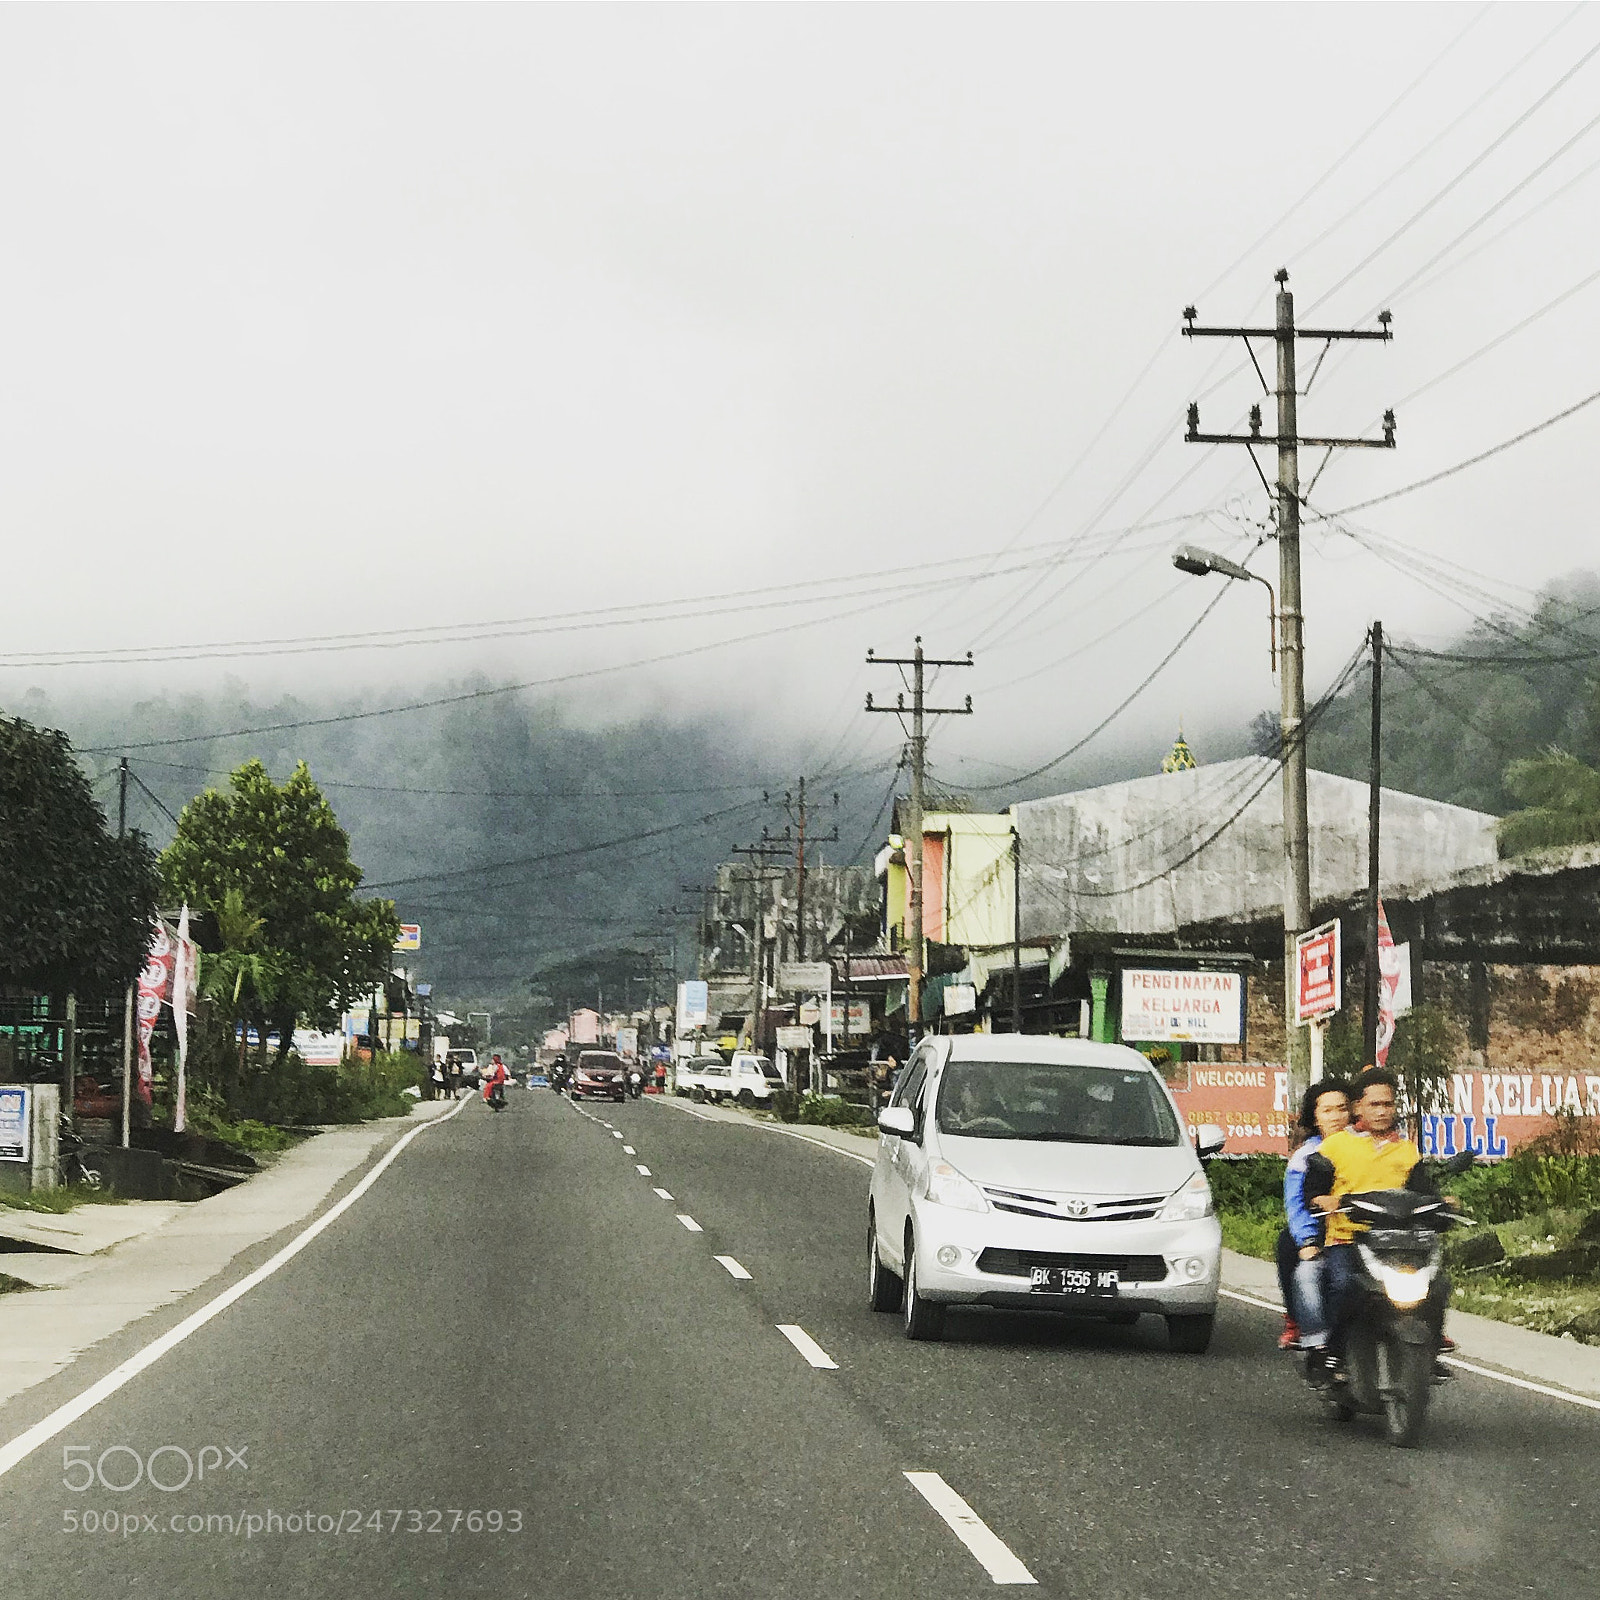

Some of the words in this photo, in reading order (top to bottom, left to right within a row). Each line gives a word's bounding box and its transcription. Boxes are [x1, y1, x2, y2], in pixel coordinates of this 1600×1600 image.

[1132, 974, 1232, 991] PENGINAPAN
[1141, 998, 1221, 1013] KELUARGA
[1195, 1071, 1267, 1087] WELCOME
[1226, 1124, 1263, 1138] 7094
[1420, 1114, 1508, 1159] HILL
[1032, 1269, 1051, 1286] BK
[1060, 1270, 1092, 1287] 1556
